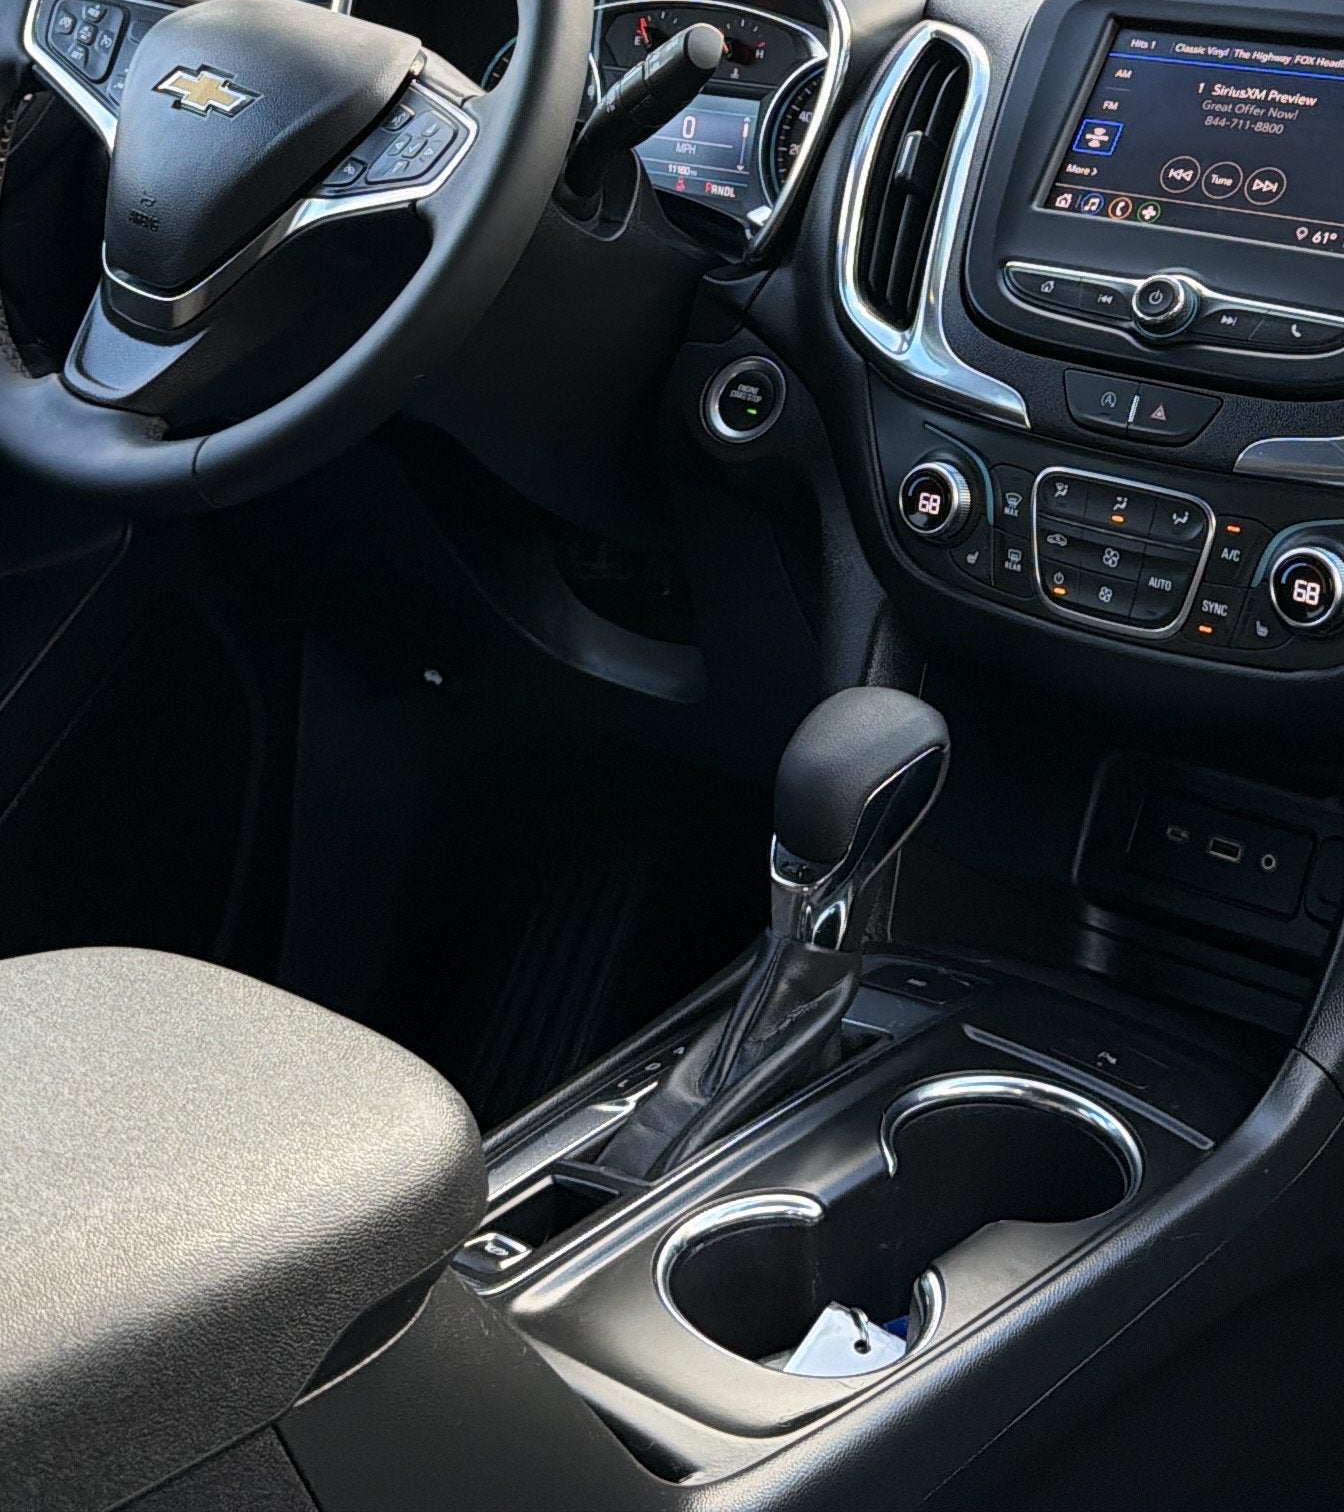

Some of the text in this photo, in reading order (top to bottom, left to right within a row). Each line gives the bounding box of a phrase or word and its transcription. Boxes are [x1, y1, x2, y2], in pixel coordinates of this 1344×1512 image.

[1131, 39, 1156, 49] Hits 1
[1175, 43, 1230, 58] Classic Vinyl
[1234, 49, 1292, 65] The Highway
[1294, 55, 1315, 65] FOX
[1115, 69, 1132, 79] AM
[1197, 82, 1318, 107] 1 SiriusXM Preview
[1102, 100, 1119, 110] FM
[1202, 99, 1299, 120] Great Offer Now!
[798, 111, 813, 123] 40
[682, 115, 696, 139] 0
[1204, 115, 1284, 135] 844-711-8800
[675, 142, 697, 155] MPH
[1066, 163, 1090, 175] More
[1210, 173, 1232, 186] Tune
[918, 492, 941, 515] 68
[1004, 506, 1020, 517] MAX
[1221, 547, 1241, 562] A/C
[1004, 560, 1022, 572] REAR
[1148, 576, 1173, 591] AUTO
[1292, 579, 1321, 606] 68
[1202, 599, 1228, 617] SYNC
